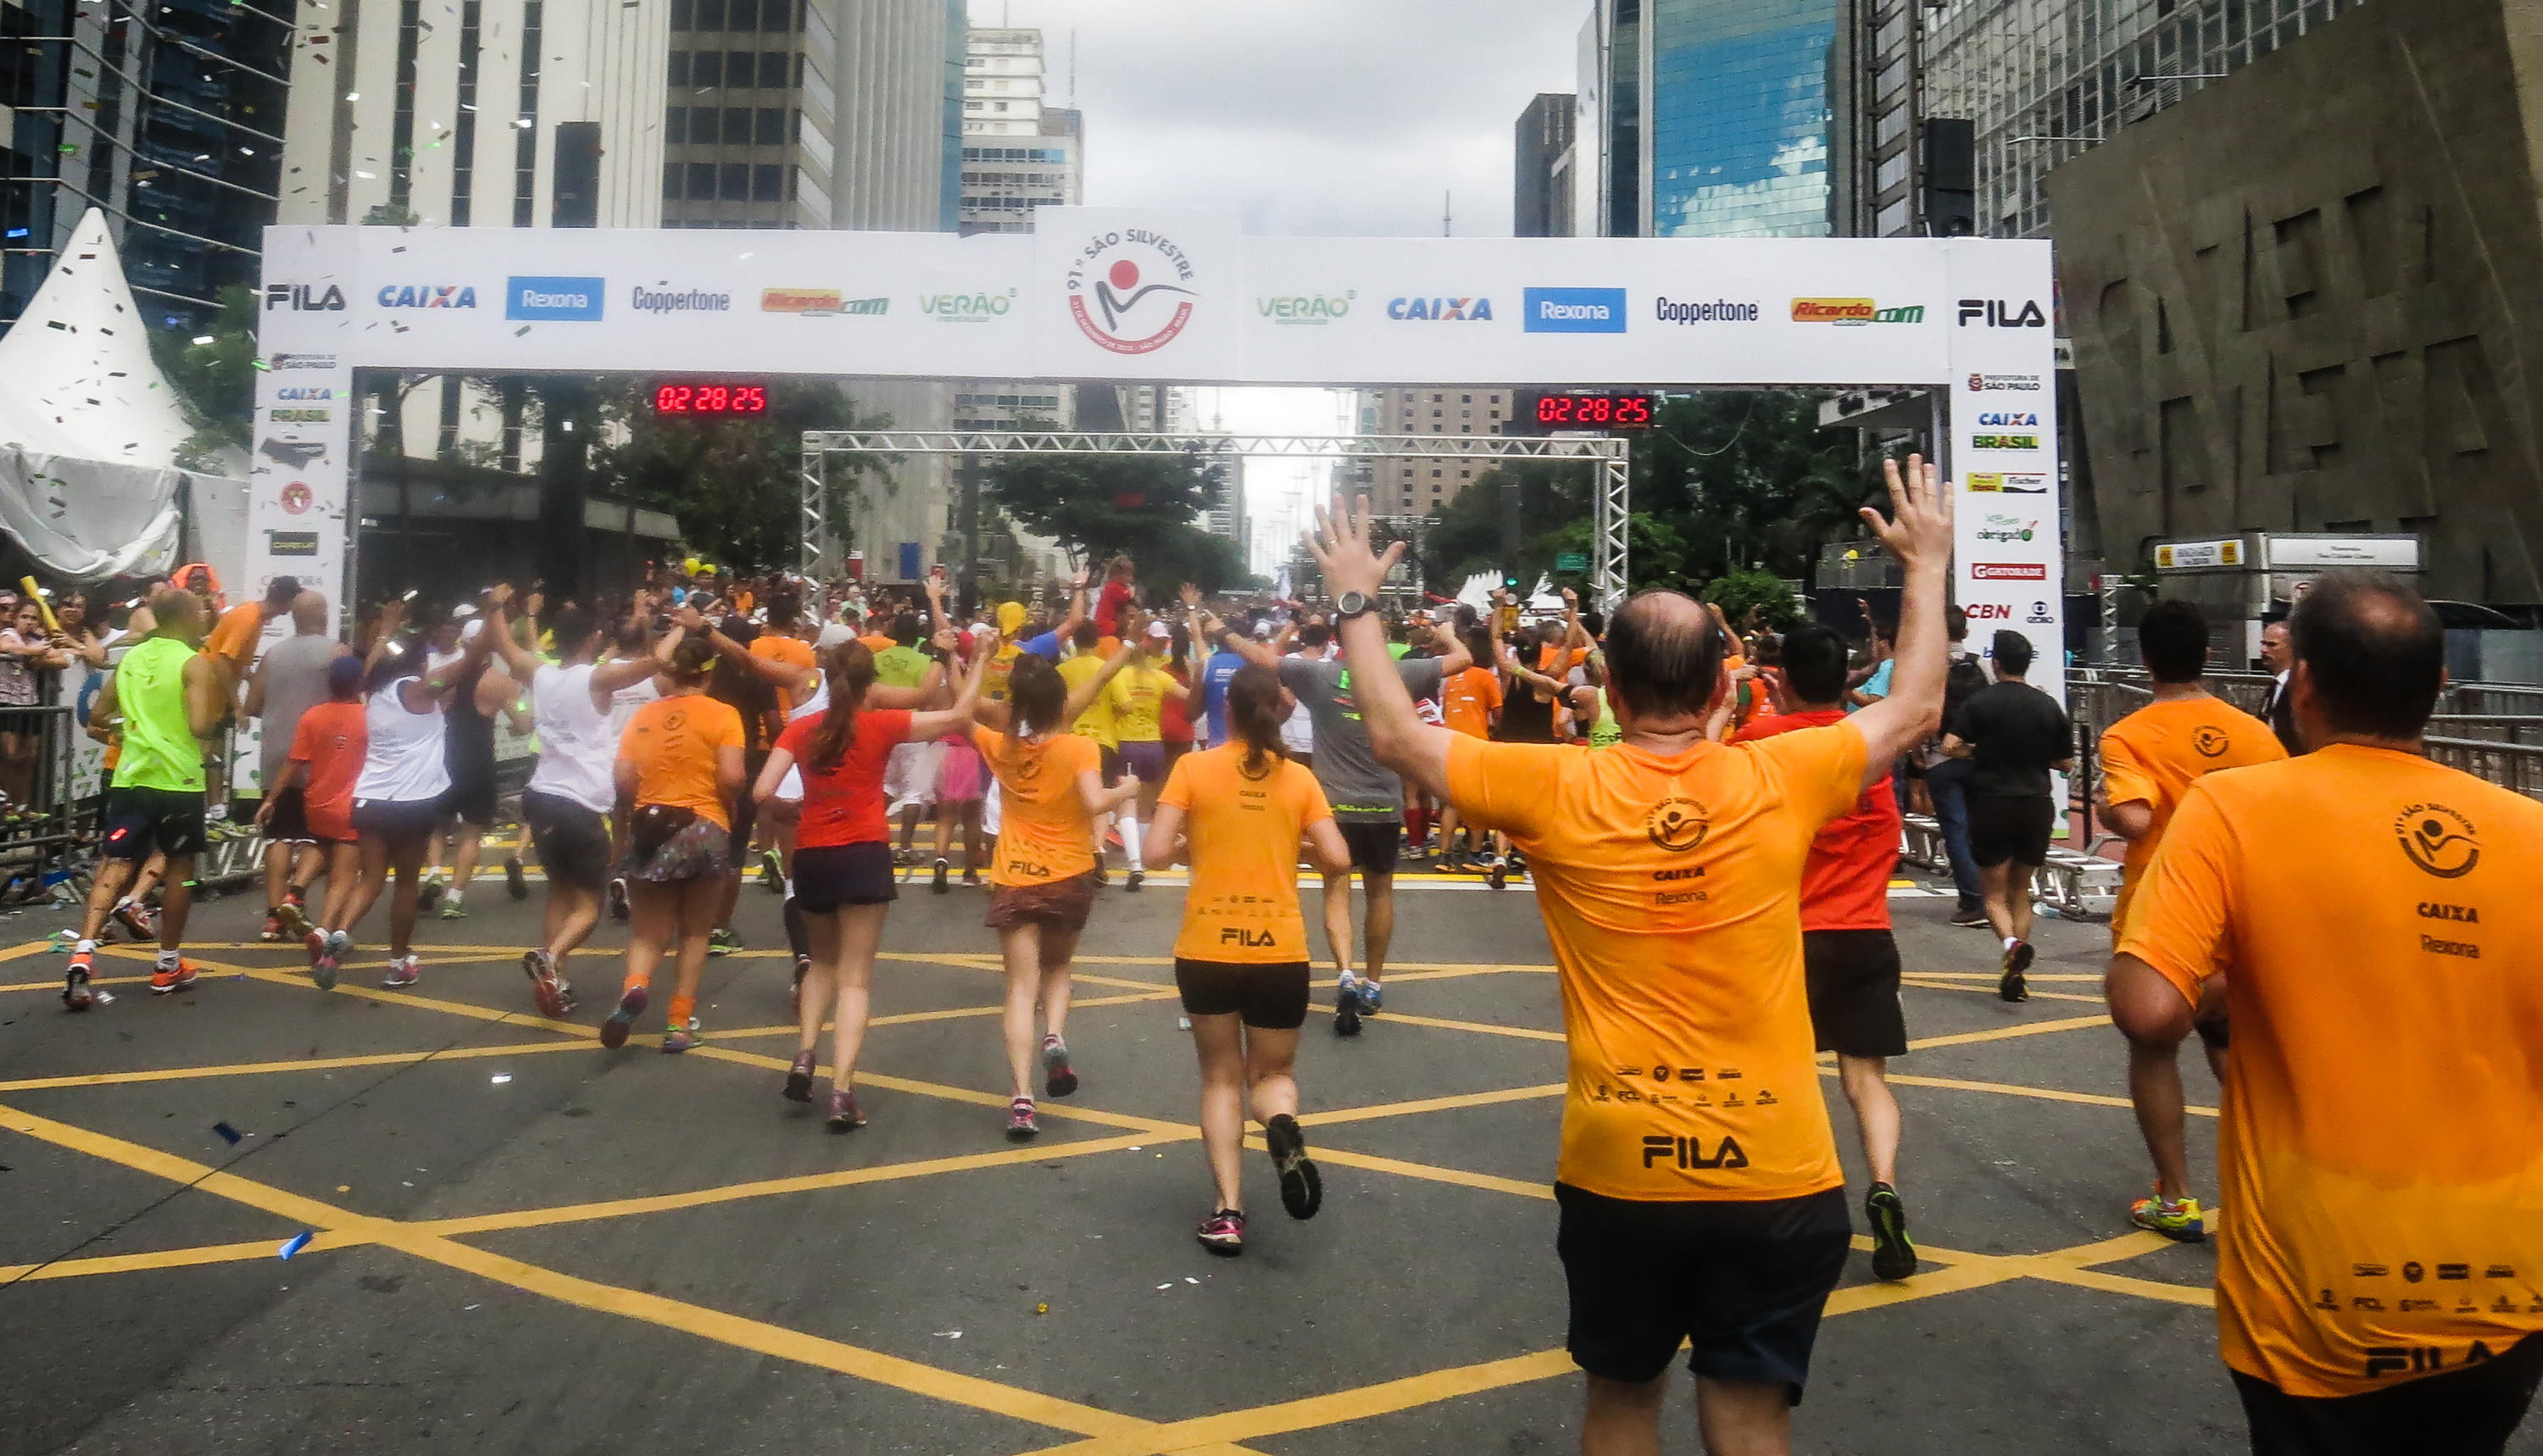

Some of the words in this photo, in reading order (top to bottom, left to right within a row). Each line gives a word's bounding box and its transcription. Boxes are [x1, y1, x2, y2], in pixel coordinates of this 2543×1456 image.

[1084, 231, 1119, 259] SÃO
[1126, 229, 1194, 281] SILVESTRE
[266, 284, 346, 310] FILA
[377, 285, 476, 308] CAIXA
[522, 289, 588, 308] Rexona
[632, 286, 731, 314] Coppertone
[1256, 293, 1349, 317] VERÃO
[1388, 297, 1492, 320] CAIXA
[1539, 301, 1610, 320] Rexona
[1656, 297, 1759, 325] Coppertone
[1795, 302, 1872, 316] Ricardo
[1958, 300, 2046, 327] FILA
[278, 388, 331, 400] CAIXA
[1984, 381, 2006, 390] SÃO
[2006, 382, 2040, 391] PAULO
[658, 386, 692, 411] 02
[694, 386, 728, 411] 28
[732, 386, 765, 411] 25
[1538, 397, 1572, 422] 02
[1576, 397, 1611, 422] 28
[1615, 397, 1649, 422] 25
[1978, 413, 2038, 425] CAIXA
[1973, 436, 2039, 448] BRASIL
[1965, 603, 2012, 619] CBN
[1008, 860, 1050, 876] FILA
[1653, 866, 1706, 881] CAIXA
[1655, 891, 1707, 904] Rexona
[2418, 901, 2479, 924] CAIXA
[1221, 927, 1276, 947] FILA
[2420, 934, 2480, 959] Rexona
[1642, 1136, 1750, 1169] FILA
